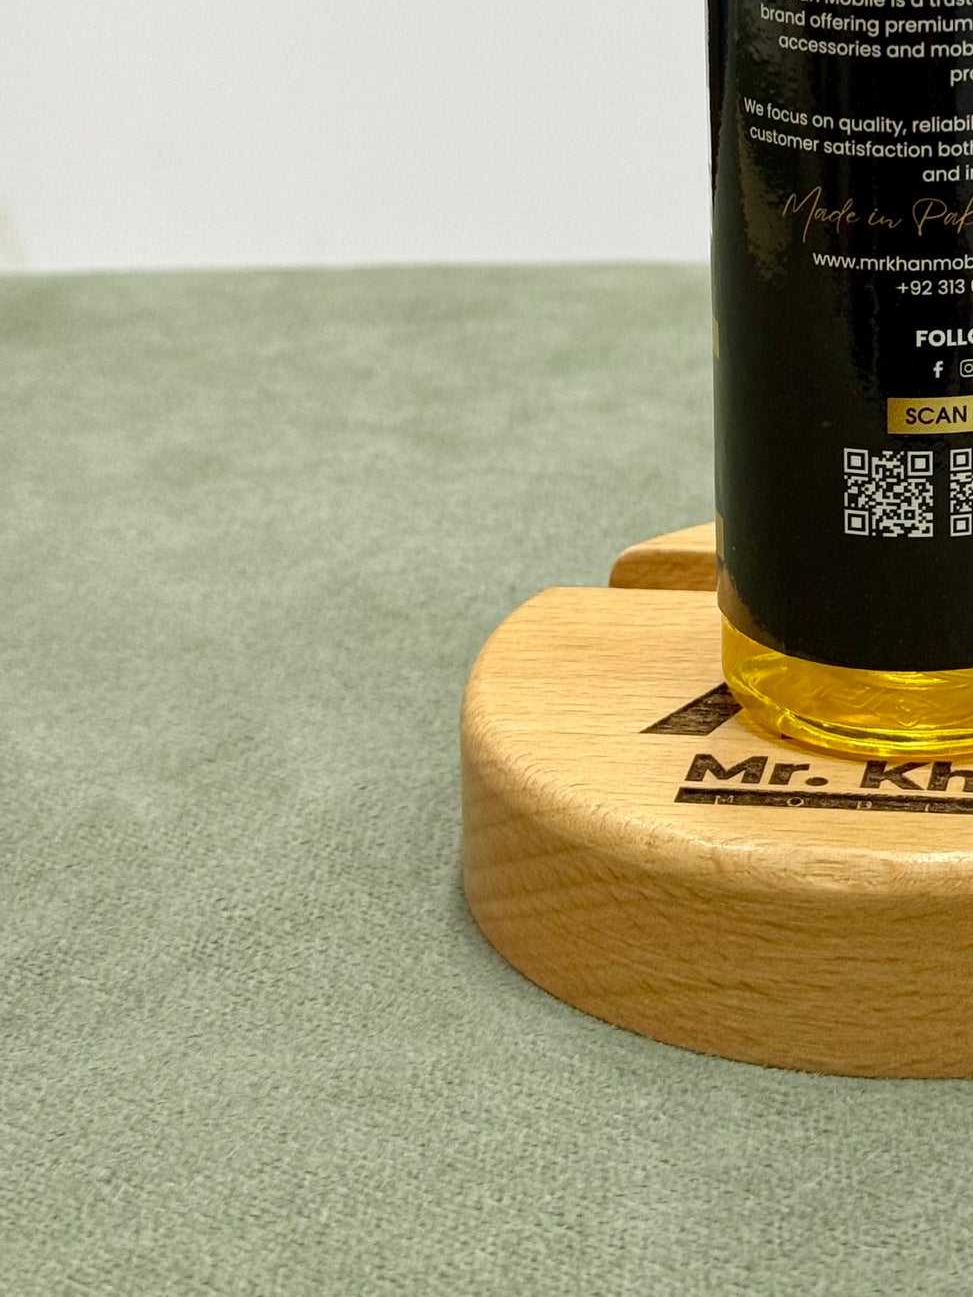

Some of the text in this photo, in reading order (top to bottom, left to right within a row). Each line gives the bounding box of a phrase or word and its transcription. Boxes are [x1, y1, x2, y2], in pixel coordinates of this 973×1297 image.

[761, 3, 805, 26] brand
[810, 13, 880, 38] offering
[885, 15, 973, 37] premium
[779, 34, 881, 57] accessories
[887, 41, 925, 58] and
[744, 98, 764, 116] We
[767, 103, 807, 126] focus
[812, 114, 833, 129] on
[839, 116, 906, 140] quality,
[750, 125, 819, 152] customer
[824, 138, 932, 158] satisfaction
[923, 165, 960, 183] and
[782, 186, 859, 243] Made
[868, 207, 902, 227] in
[897, 279, 932, 296] +92
[938, 278, 965, 295] 313
[905, 405, 967, 426] SCAN
[684, 753, 829, 787] Mr.
